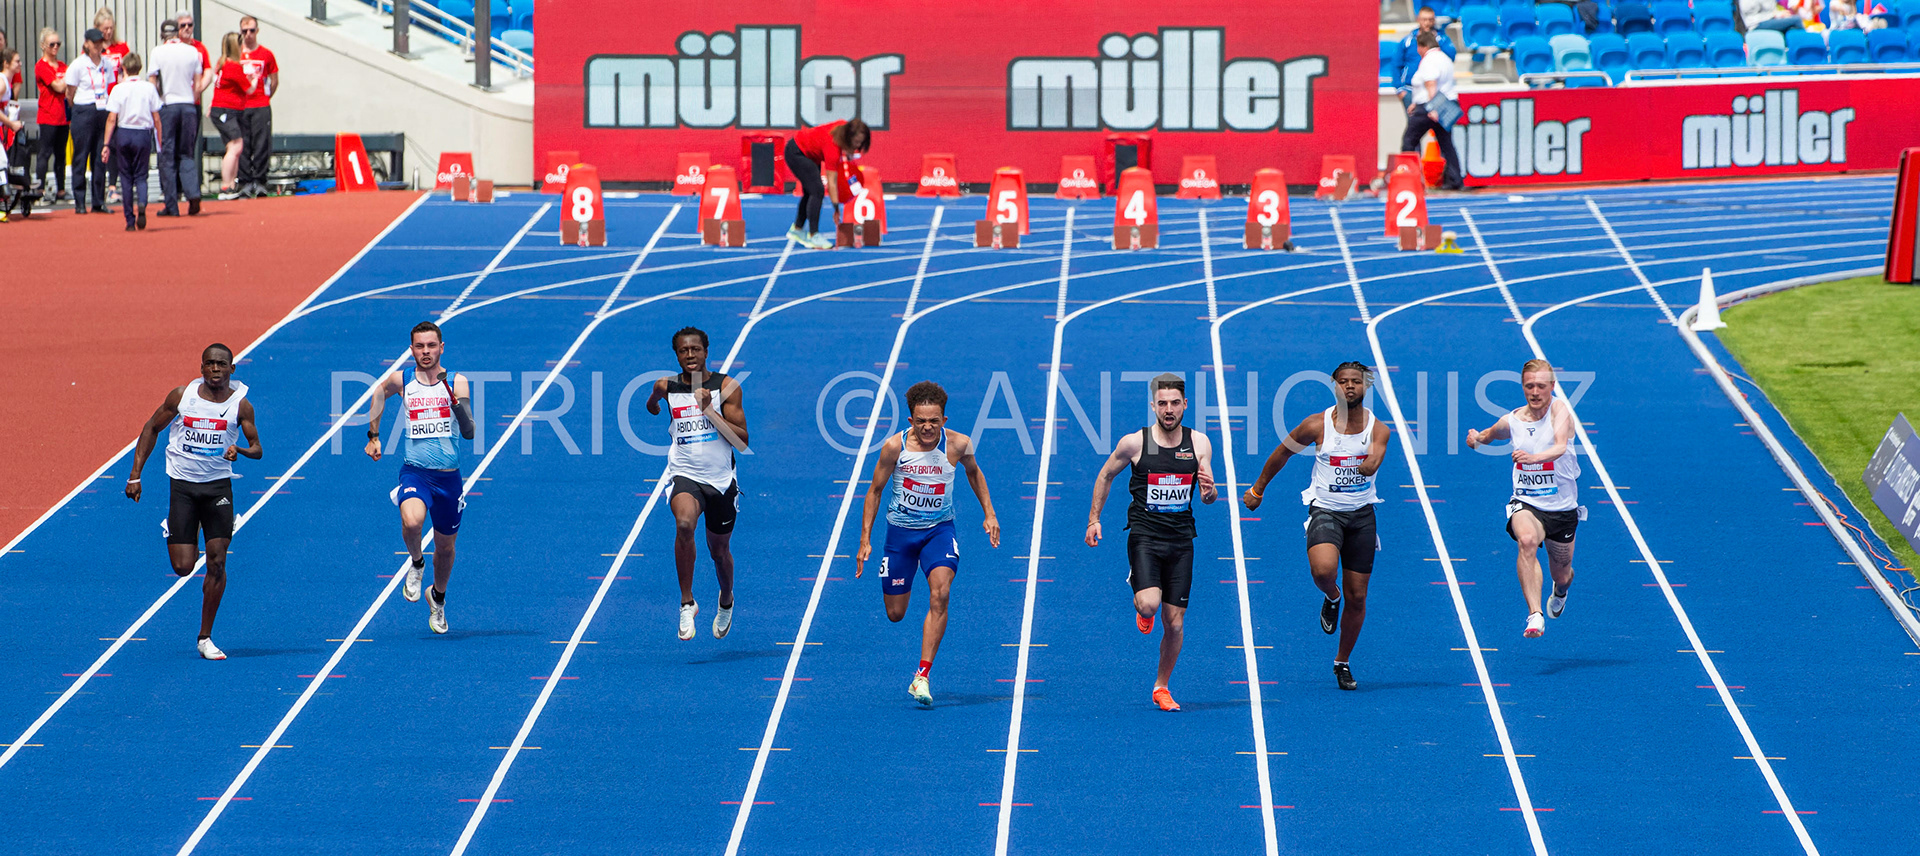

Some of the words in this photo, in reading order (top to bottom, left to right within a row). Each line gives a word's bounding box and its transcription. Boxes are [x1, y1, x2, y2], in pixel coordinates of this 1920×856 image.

[584, 25, 904, 130] müller
[1006, 26, 1328, 132] müller
[1682, 89, 1855, 170] müller
[348, 151, 364, 185] 1
[676, 174, 705, 185] OMEG
[920, 175, 957, 187] OMEGA
[1060, 178, 1097, 189] OMEGA
[1180, 178, 1218, 189] OMEGA
[571, 186, 594, 223] 8
[710, 187, 730, 220] 7
[853, 188, 876, 224] 6
[996, 190, 1018, 224] 5
[1123, 189, 1148, 226] 4
[1256, 189, 1280, 227] 3
[1395, 190, 1418, 228] 2
[425, 396, 449, 407] BRITAIN
[417, 408, 441, 420] müller
[192, 418, 217, 430] müller
[412, 421, 451, 436] BRIDGE
[185, 430, 224, 445] SAMUEL
[918, 465, 943, 475] BRITAIN
[1158, 474, 1183, 485] müller
[1335, 476, 1367, 485] COKER
[1517, 473, 1554, 486] ARNOTT
[912, 483, 936, 495] müller
[1151, 488, 1188, 501] SHAW
[903, 490, 943, 508] YOUNG
